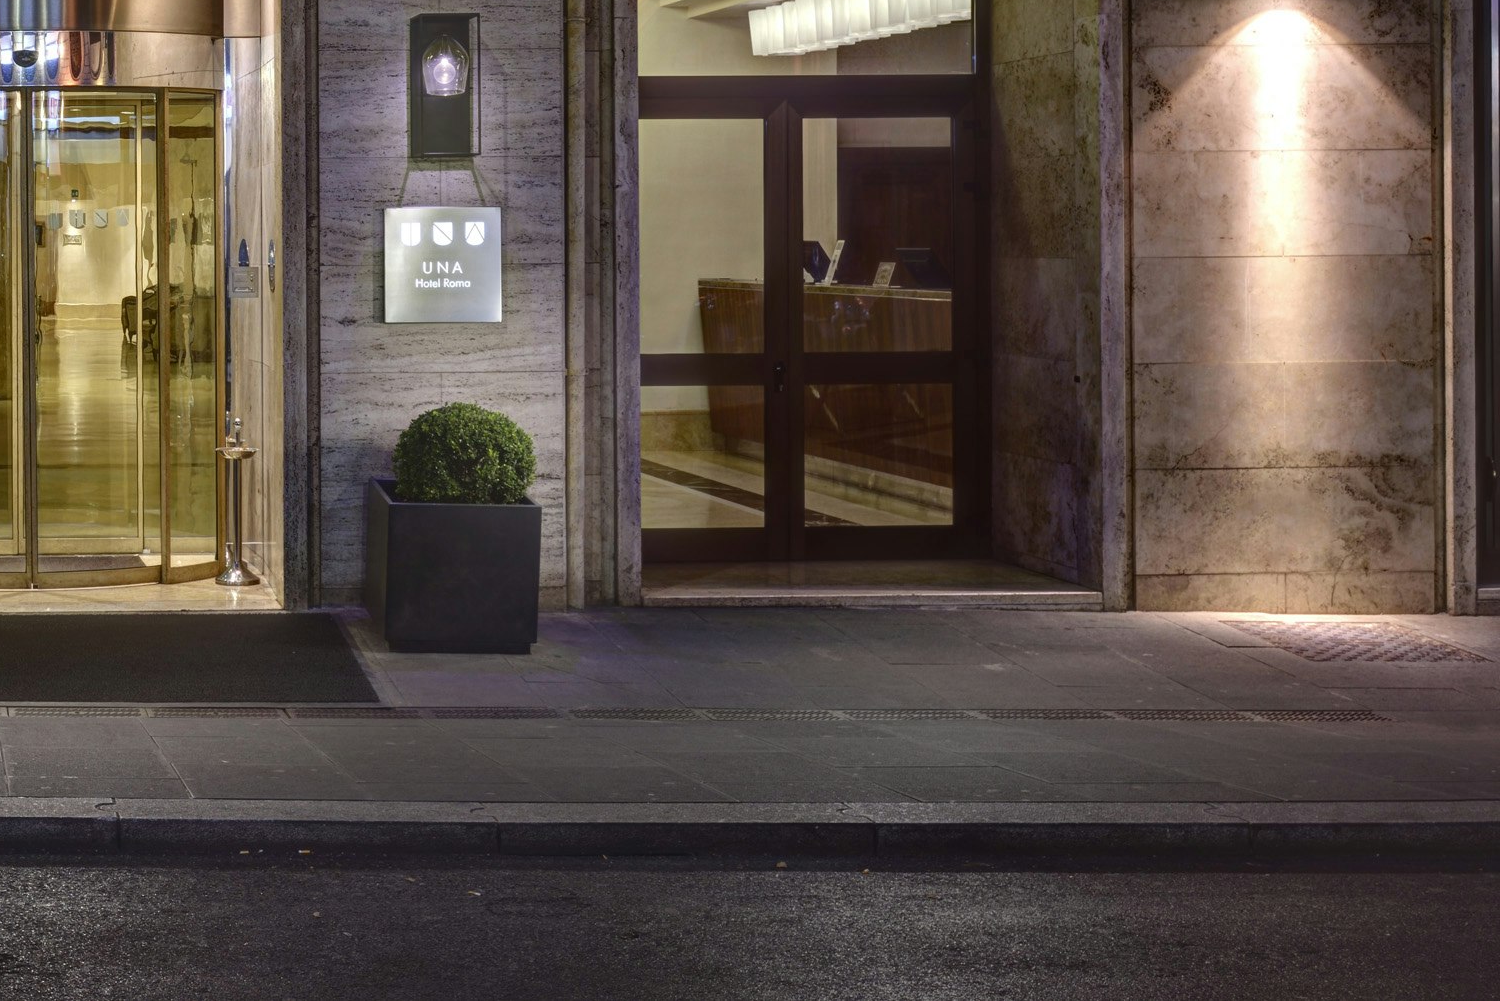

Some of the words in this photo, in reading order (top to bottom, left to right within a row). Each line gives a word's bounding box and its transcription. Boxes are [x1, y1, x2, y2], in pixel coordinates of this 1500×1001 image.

[422, 261, 463, 275] UNA
[415, 278, 441, 288] Hotel
[443, 279, 471, 288] Roma
